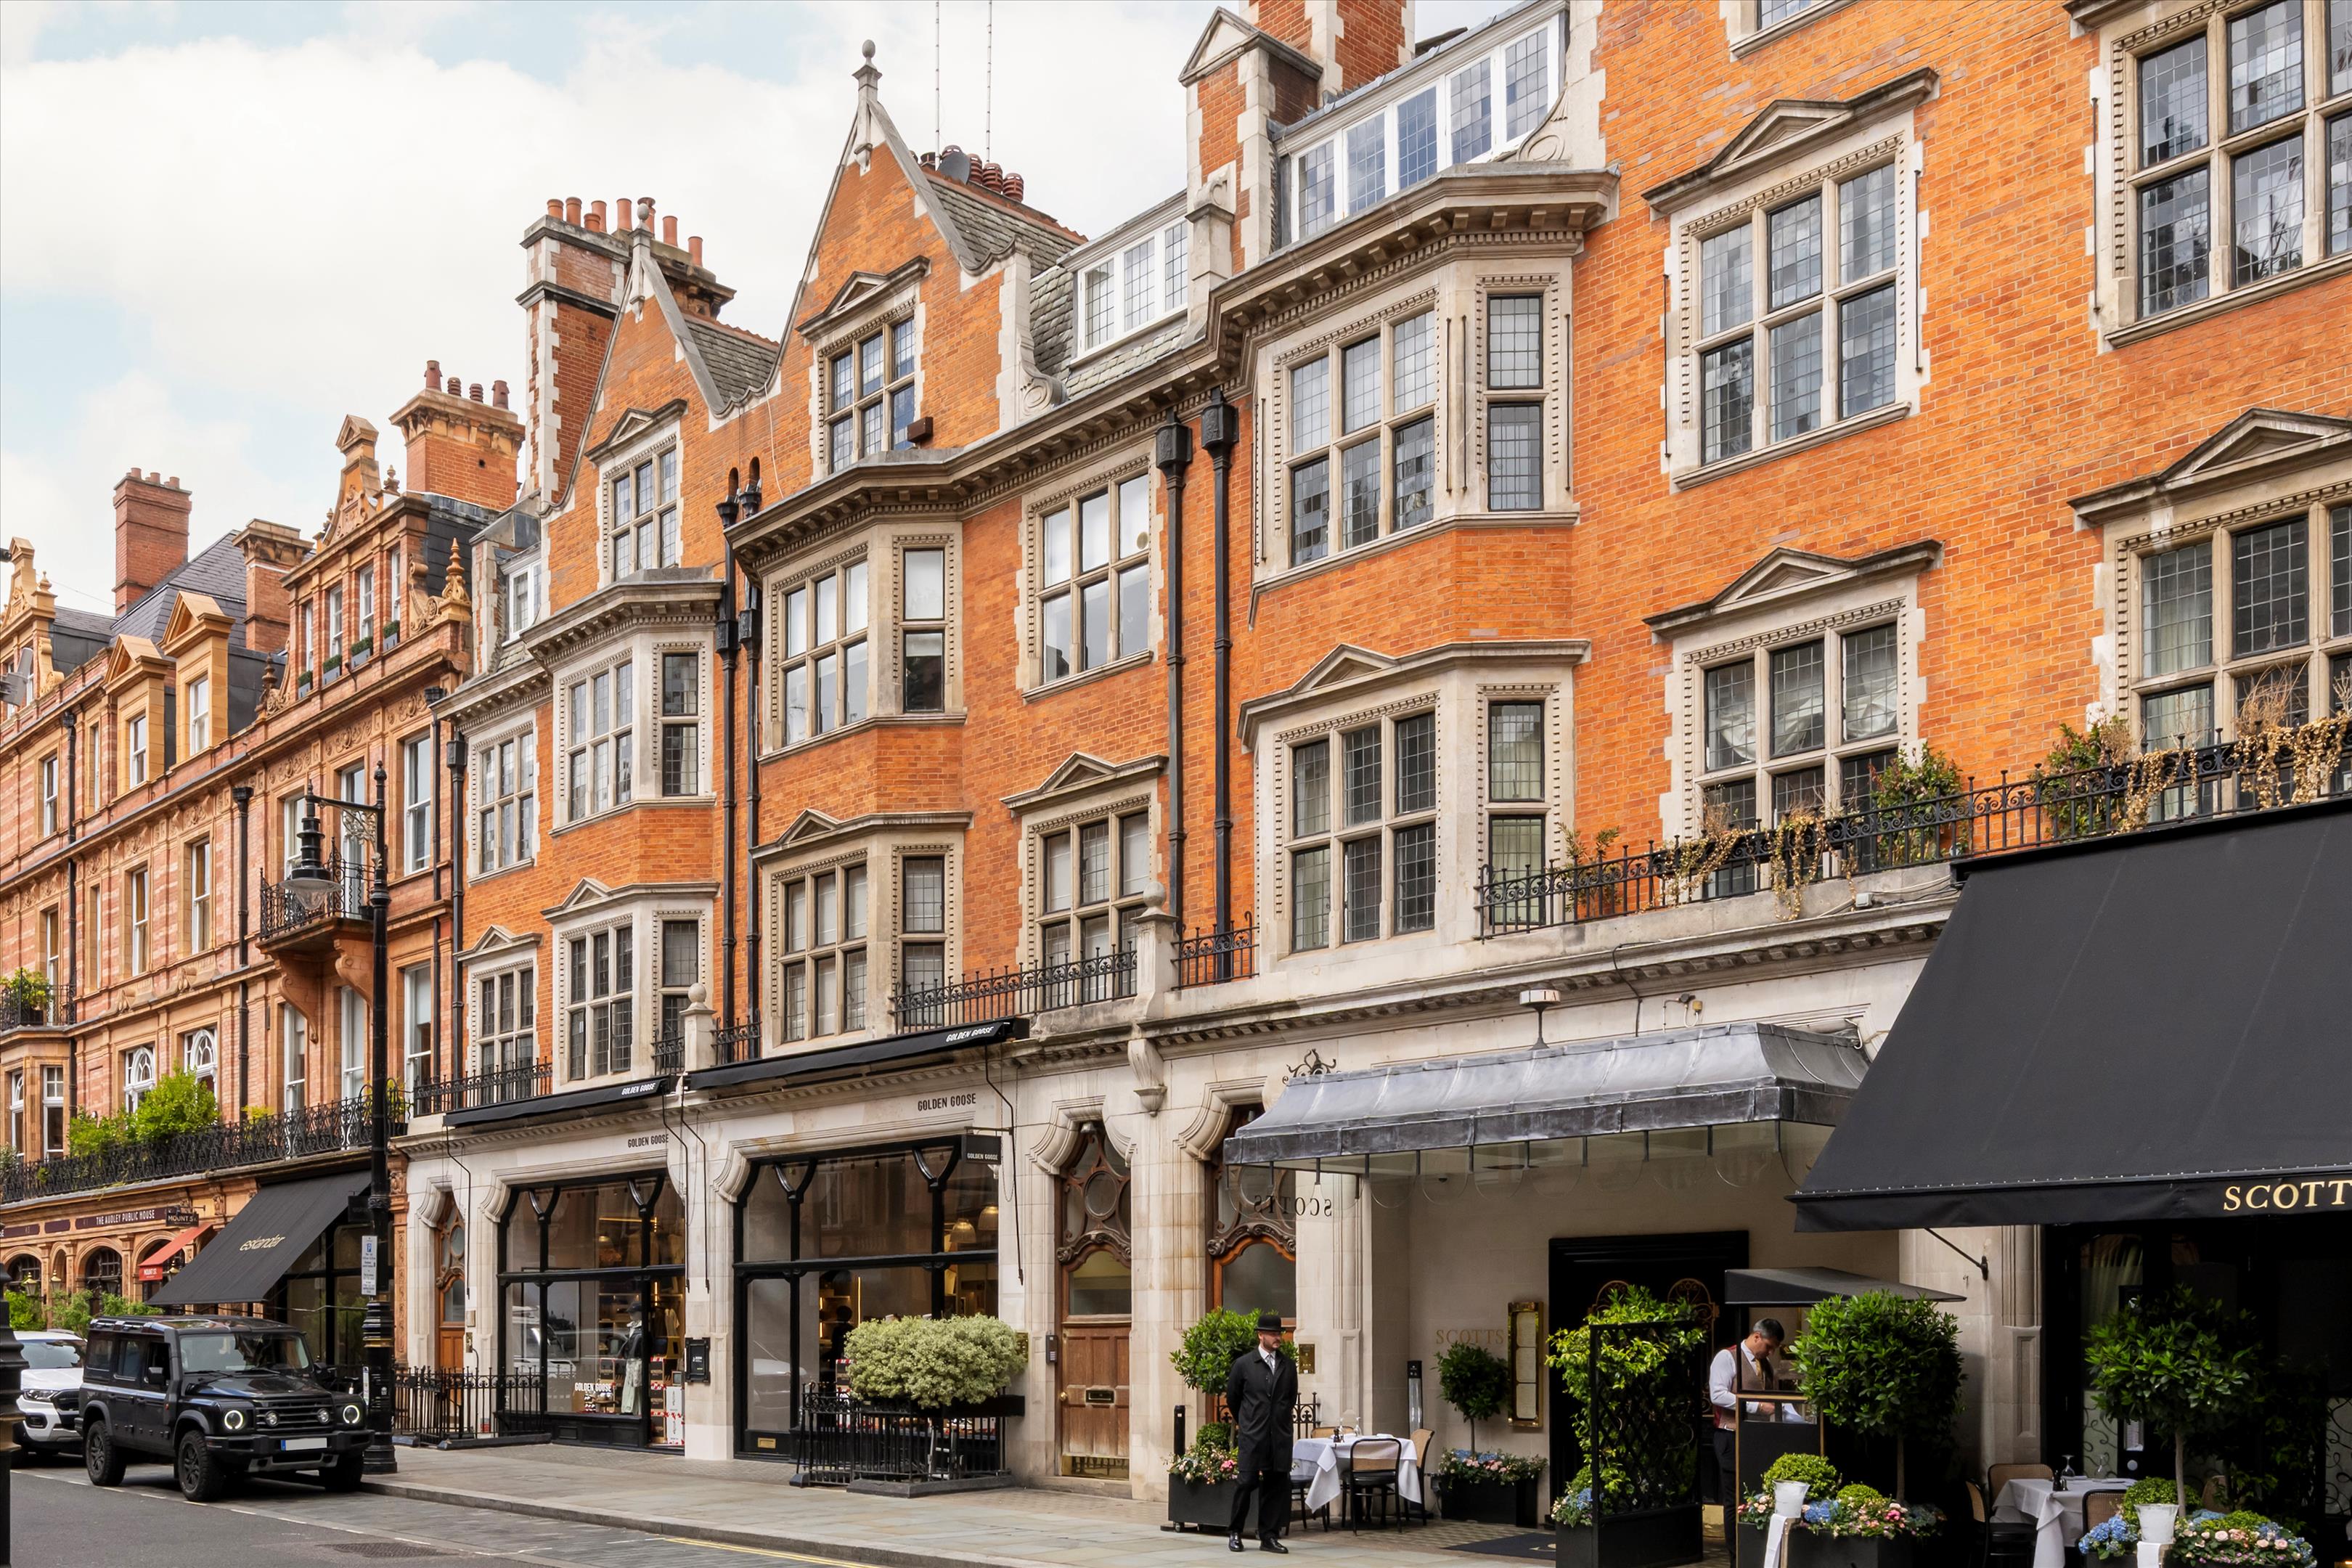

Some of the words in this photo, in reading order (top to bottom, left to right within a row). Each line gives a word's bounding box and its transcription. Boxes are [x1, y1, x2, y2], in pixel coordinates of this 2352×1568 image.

[946, 1031, 971, 1042] GOLDEN
[971, 1026, 994, 1037] GOOSE
[621, 1086, 639, 1095] GOLDEN
[640, 1083, 656, 1092] GOOSE
[918, 1097, 947, 1111] GOLDEN
[950, 1093, 976, 1107] GOOSE
[628, 1137, 649, 1148] GOLDEN
[650, 1134, 669, 1145] GOOSE
[2224, 1180, 2352, 1211] SCOTT
[105, 1214, 121, 1224] AUDLEY
[122, 1212, 138, 1222] PUBLIC
[139, 1209, 155, 1220] HOUSE
[1436, 1329, 1504, 1344] SCOTTS
[575, 1382, 594, 1392] GOLDEN
[595, 1383, 612, 1392] GOOSE
